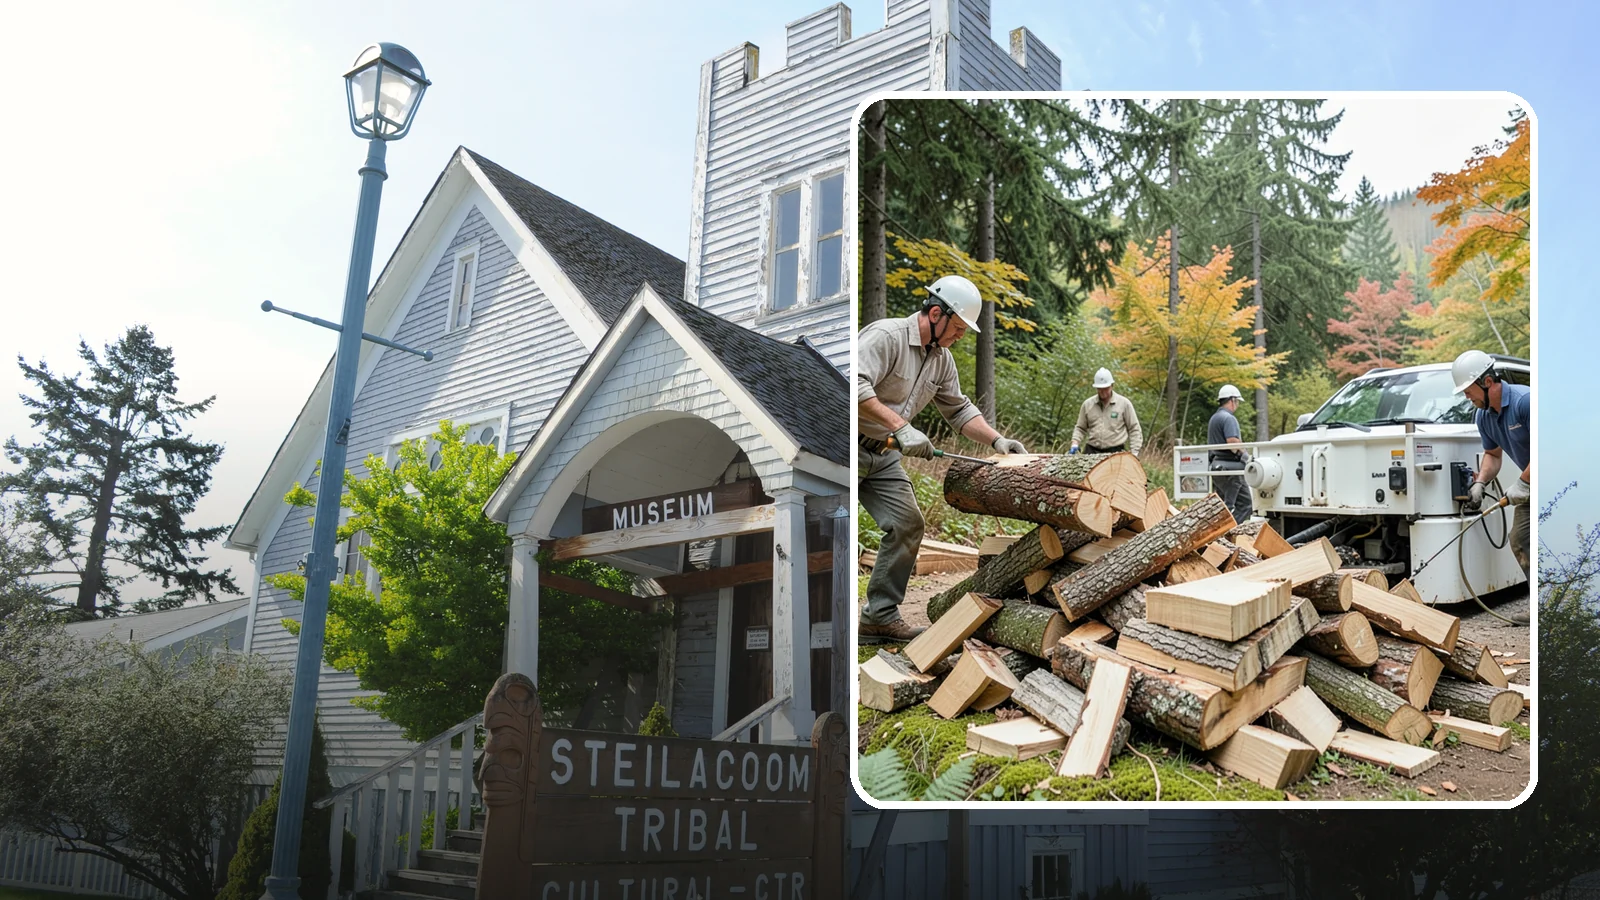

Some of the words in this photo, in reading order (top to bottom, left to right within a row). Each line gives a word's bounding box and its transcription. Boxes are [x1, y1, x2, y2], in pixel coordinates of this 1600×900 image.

[613, 491, 714, 531] MUSEUM
[550, 738, 810, 793] STEILACOOM
[614, 806, 758, 852] TRIBAL
